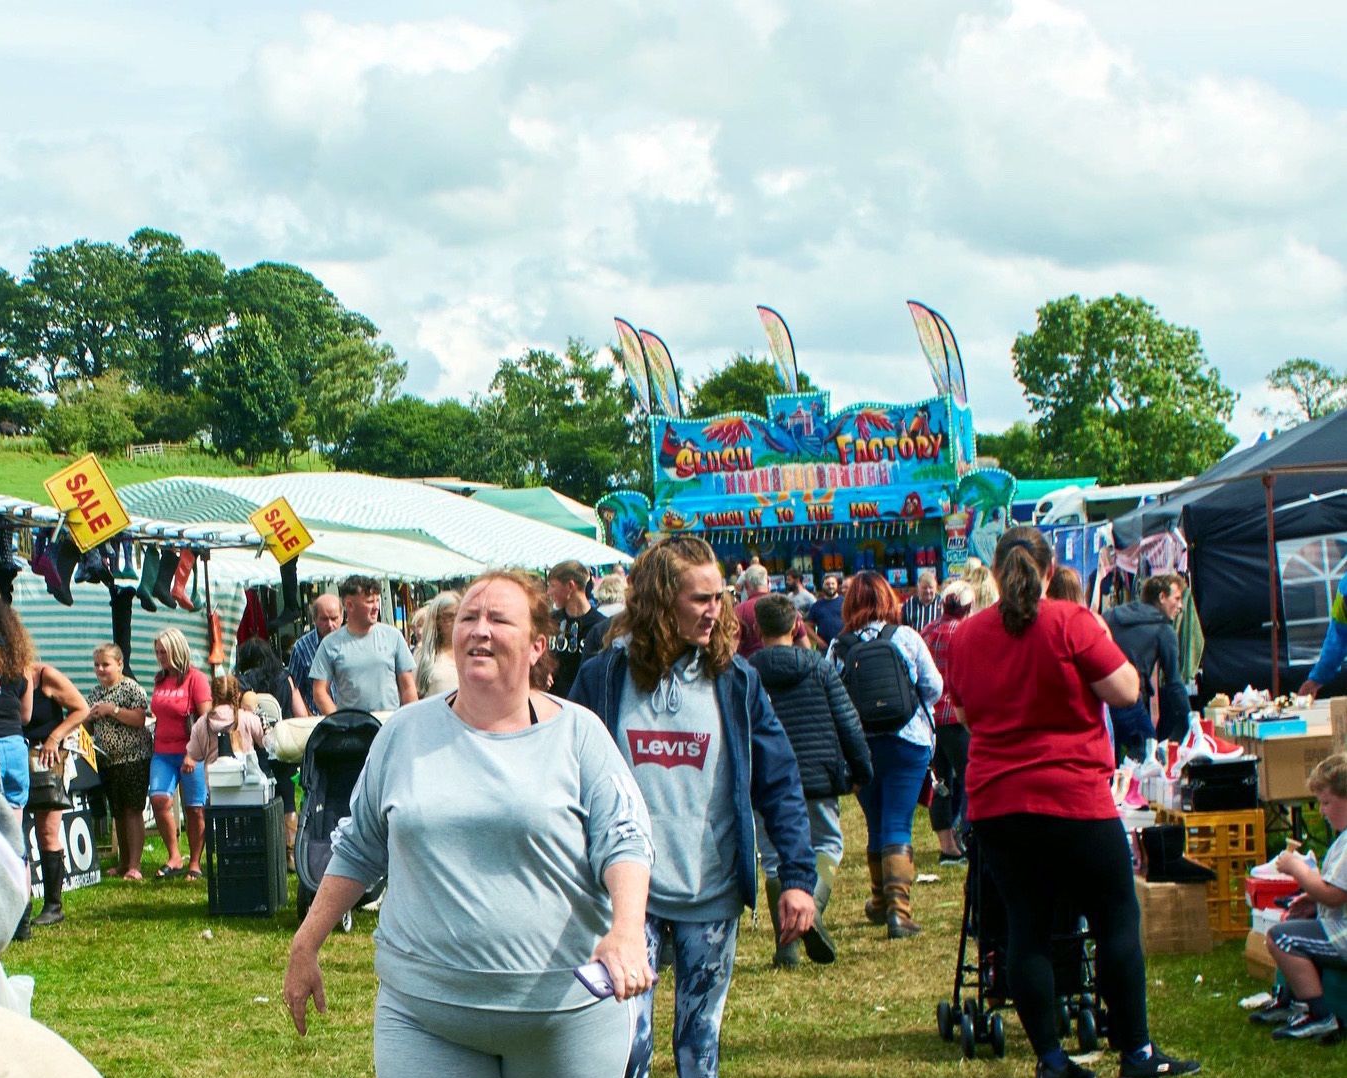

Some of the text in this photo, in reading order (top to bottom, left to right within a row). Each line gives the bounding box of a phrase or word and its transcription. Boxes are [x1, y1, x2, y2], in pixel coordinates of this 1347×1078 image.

[675, 432, 943, 479] SLUSH FACTORY
[65, 472, 113, 535] SALE
[749, 507, 763, 525] IT
[775, 506, 795, 523] TO
[806, 503, 833, 522] THE
[850, 501, 881, 519] MAX
[264, 507, 301, 553] SALE
